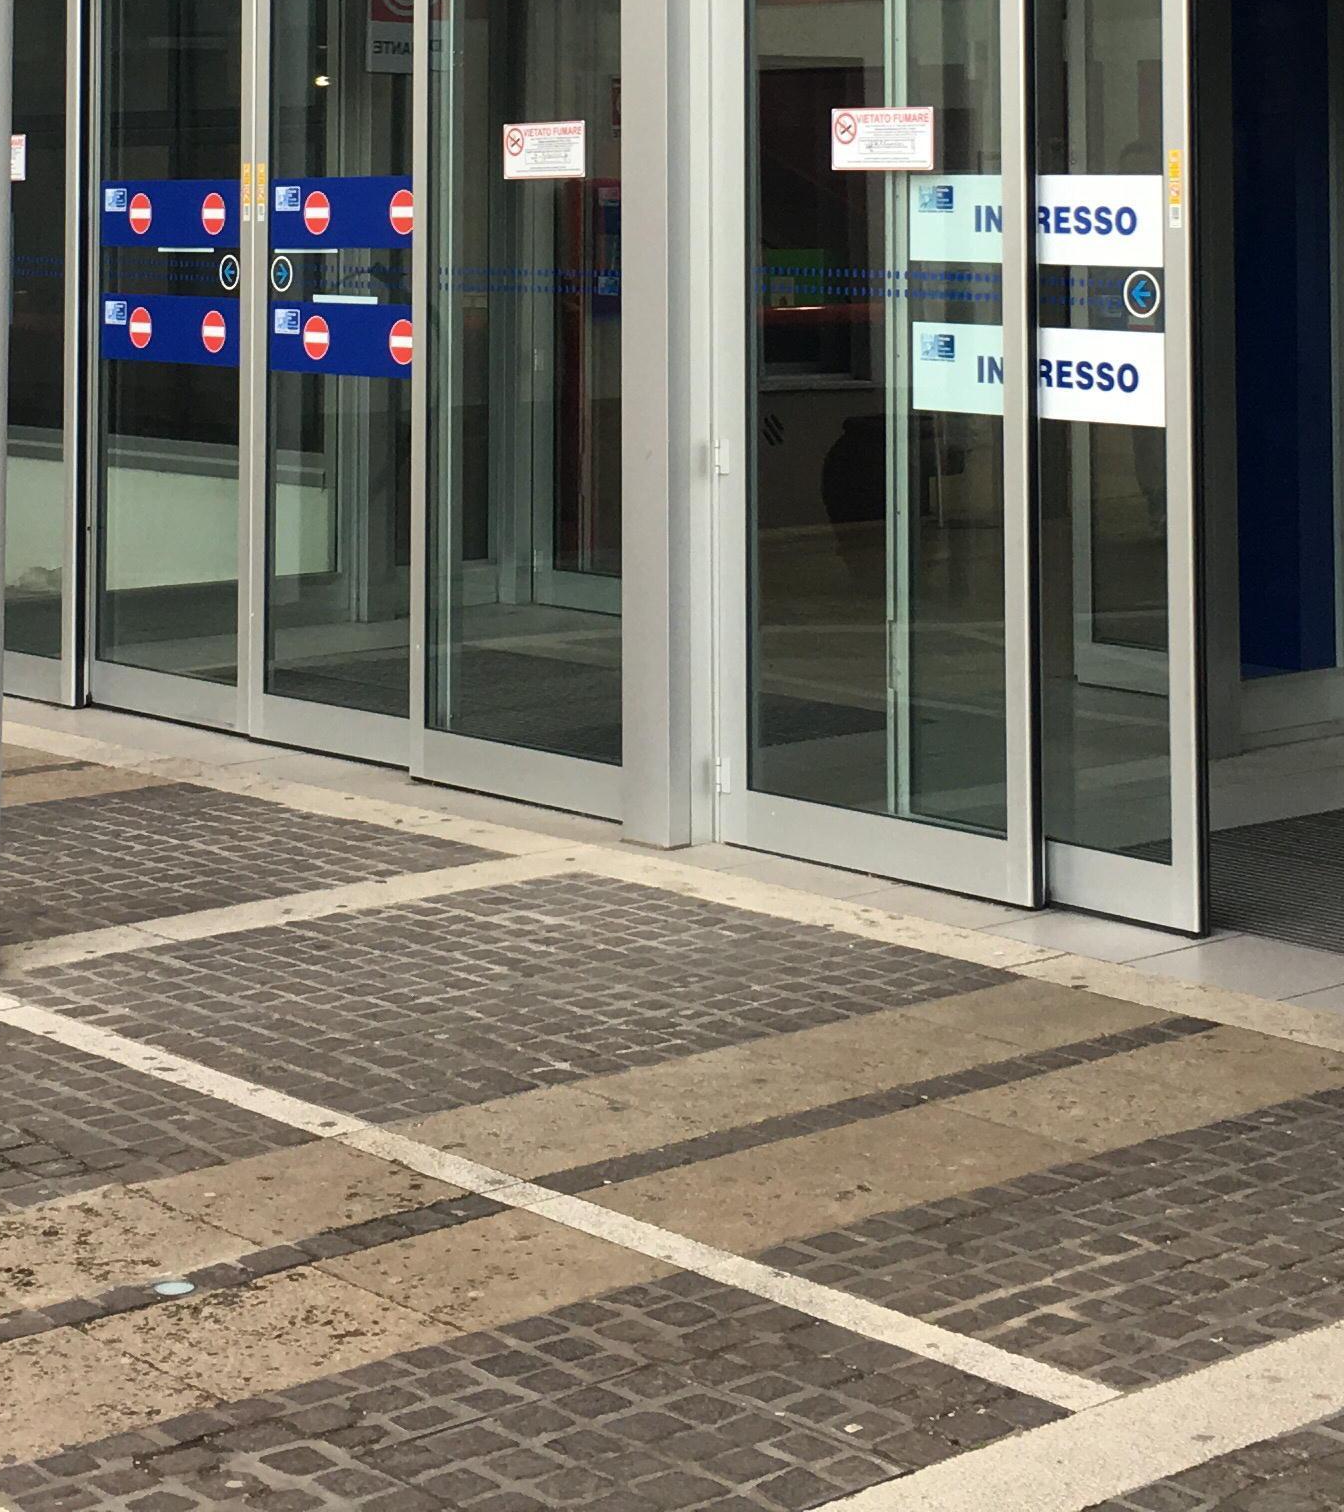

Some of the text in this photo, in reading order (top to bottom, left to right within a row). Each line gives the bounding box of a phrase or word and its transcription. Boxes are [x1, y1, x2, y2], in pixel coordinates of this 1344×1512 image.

[856, 112, 929, 124] VIETATO FUMARE
[523, 126, 582, 138] VIETATO FUMARE
[975, 205, 1138, 236] INRESSO
[977, 355, 1140, 393] INRESSO
